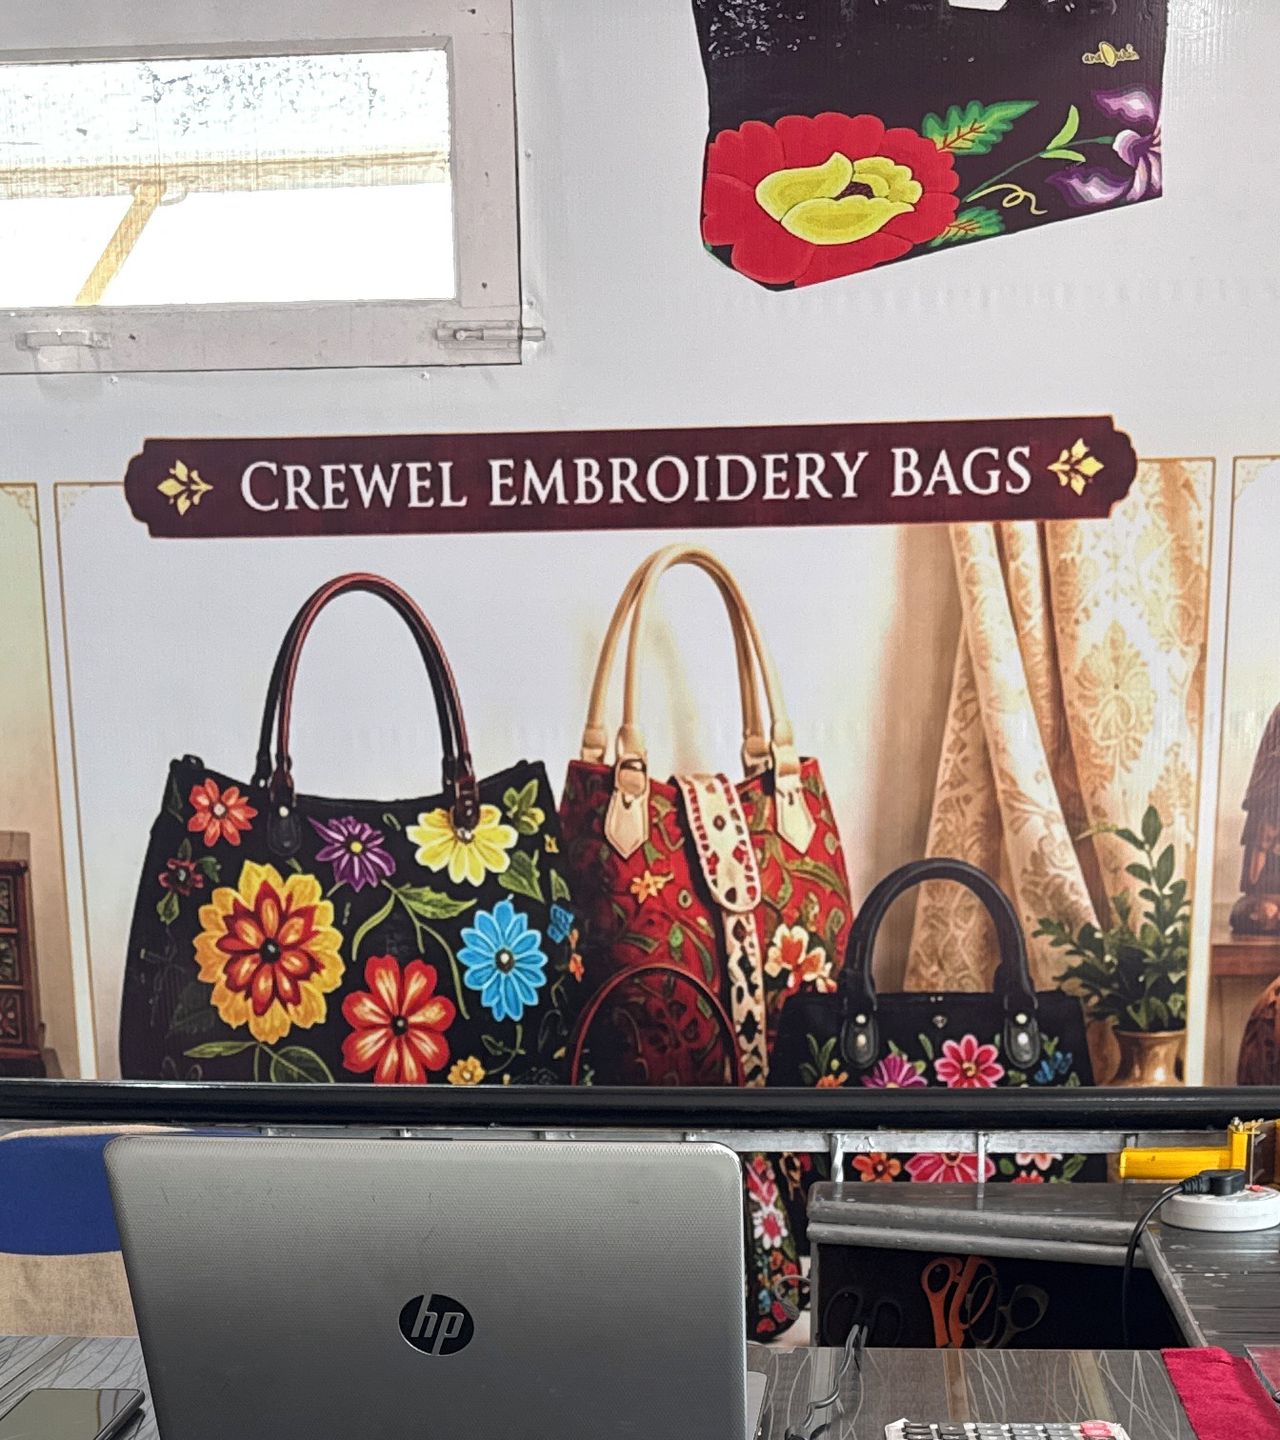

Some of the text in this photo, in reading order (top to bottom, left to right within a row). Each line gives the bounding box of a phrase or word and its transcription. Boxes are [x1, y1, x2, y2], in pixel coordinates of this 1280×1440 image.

[240, 445, 1032, 512] CREWEL EMBROIDERY BAGS
[410, 1292, 465, 1356] hp
